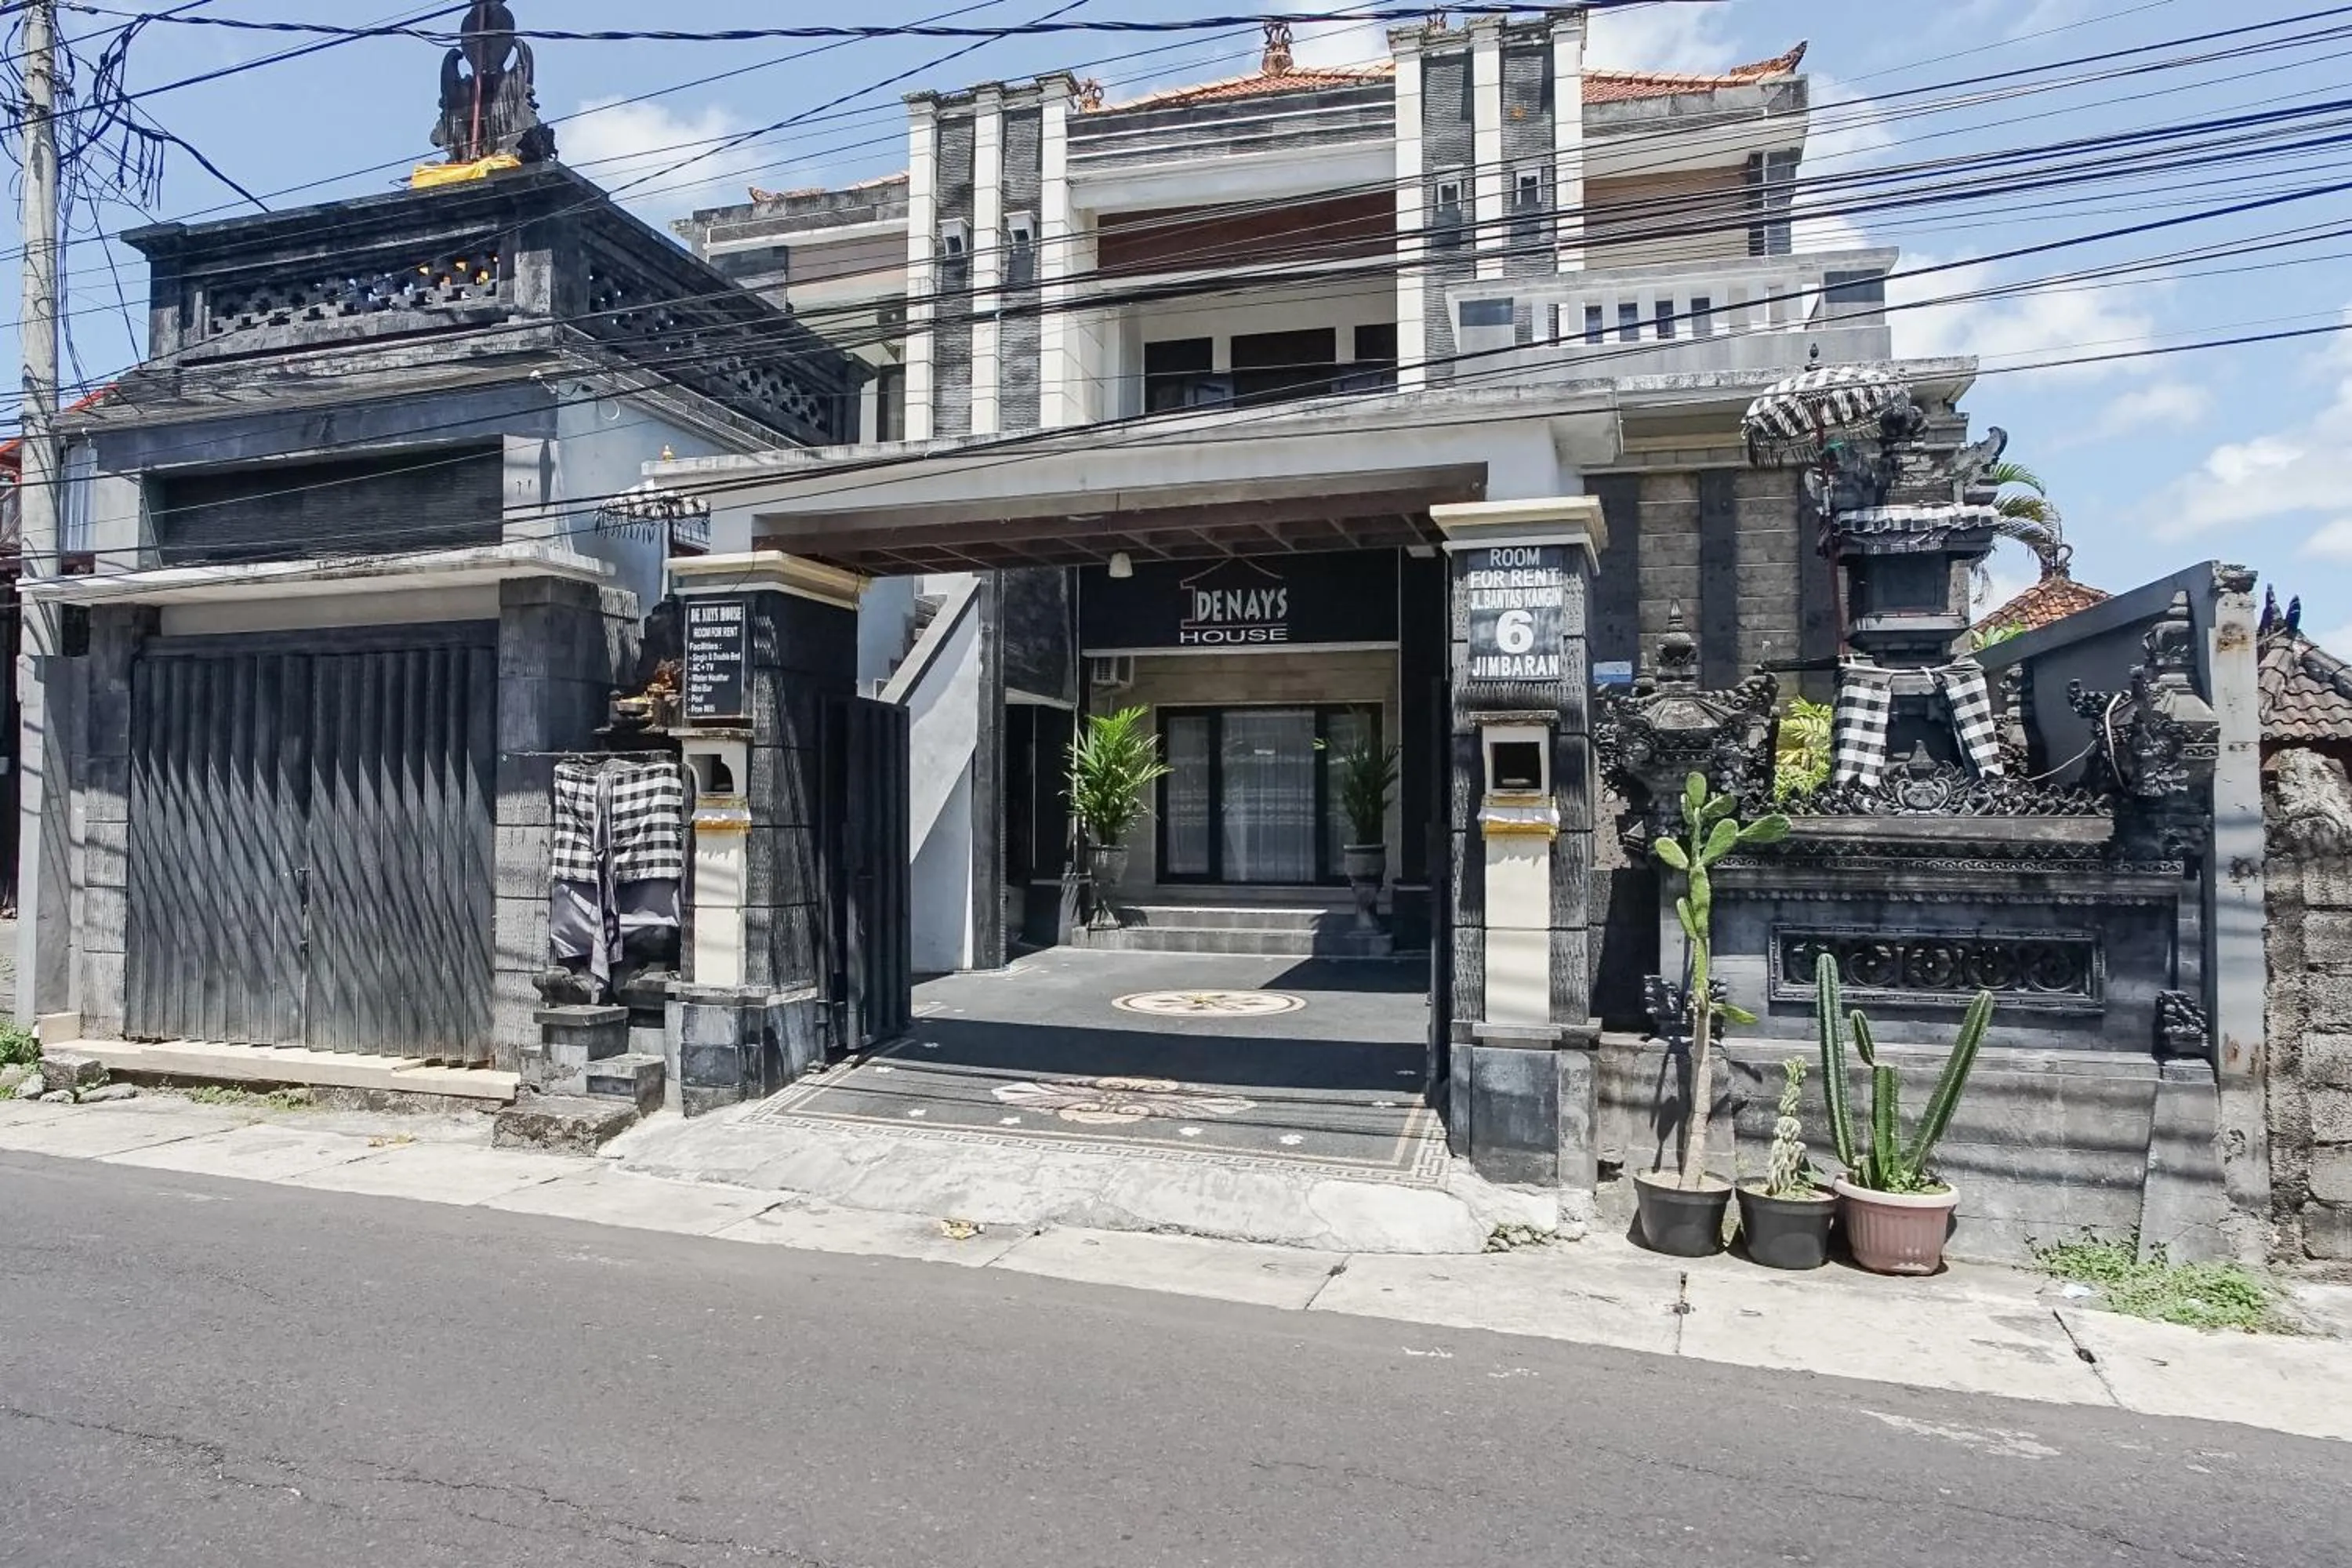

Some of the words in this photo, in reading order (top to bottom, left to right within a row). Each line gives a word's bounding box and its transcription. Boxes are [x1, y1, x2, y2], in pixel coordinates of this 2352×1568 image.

[1490, 547, 1541, 567] ROOM
[1470, 570, 1504, 589] FOR
[1511, 568, 1560, 586] RENT
[722, 626, 738, 637] RENT
[1180, 628, 1287, 644] HOUSE
[1497, 609, 1534, 654] 6
[1472, 655, 1559, 677] JIMBARAN
